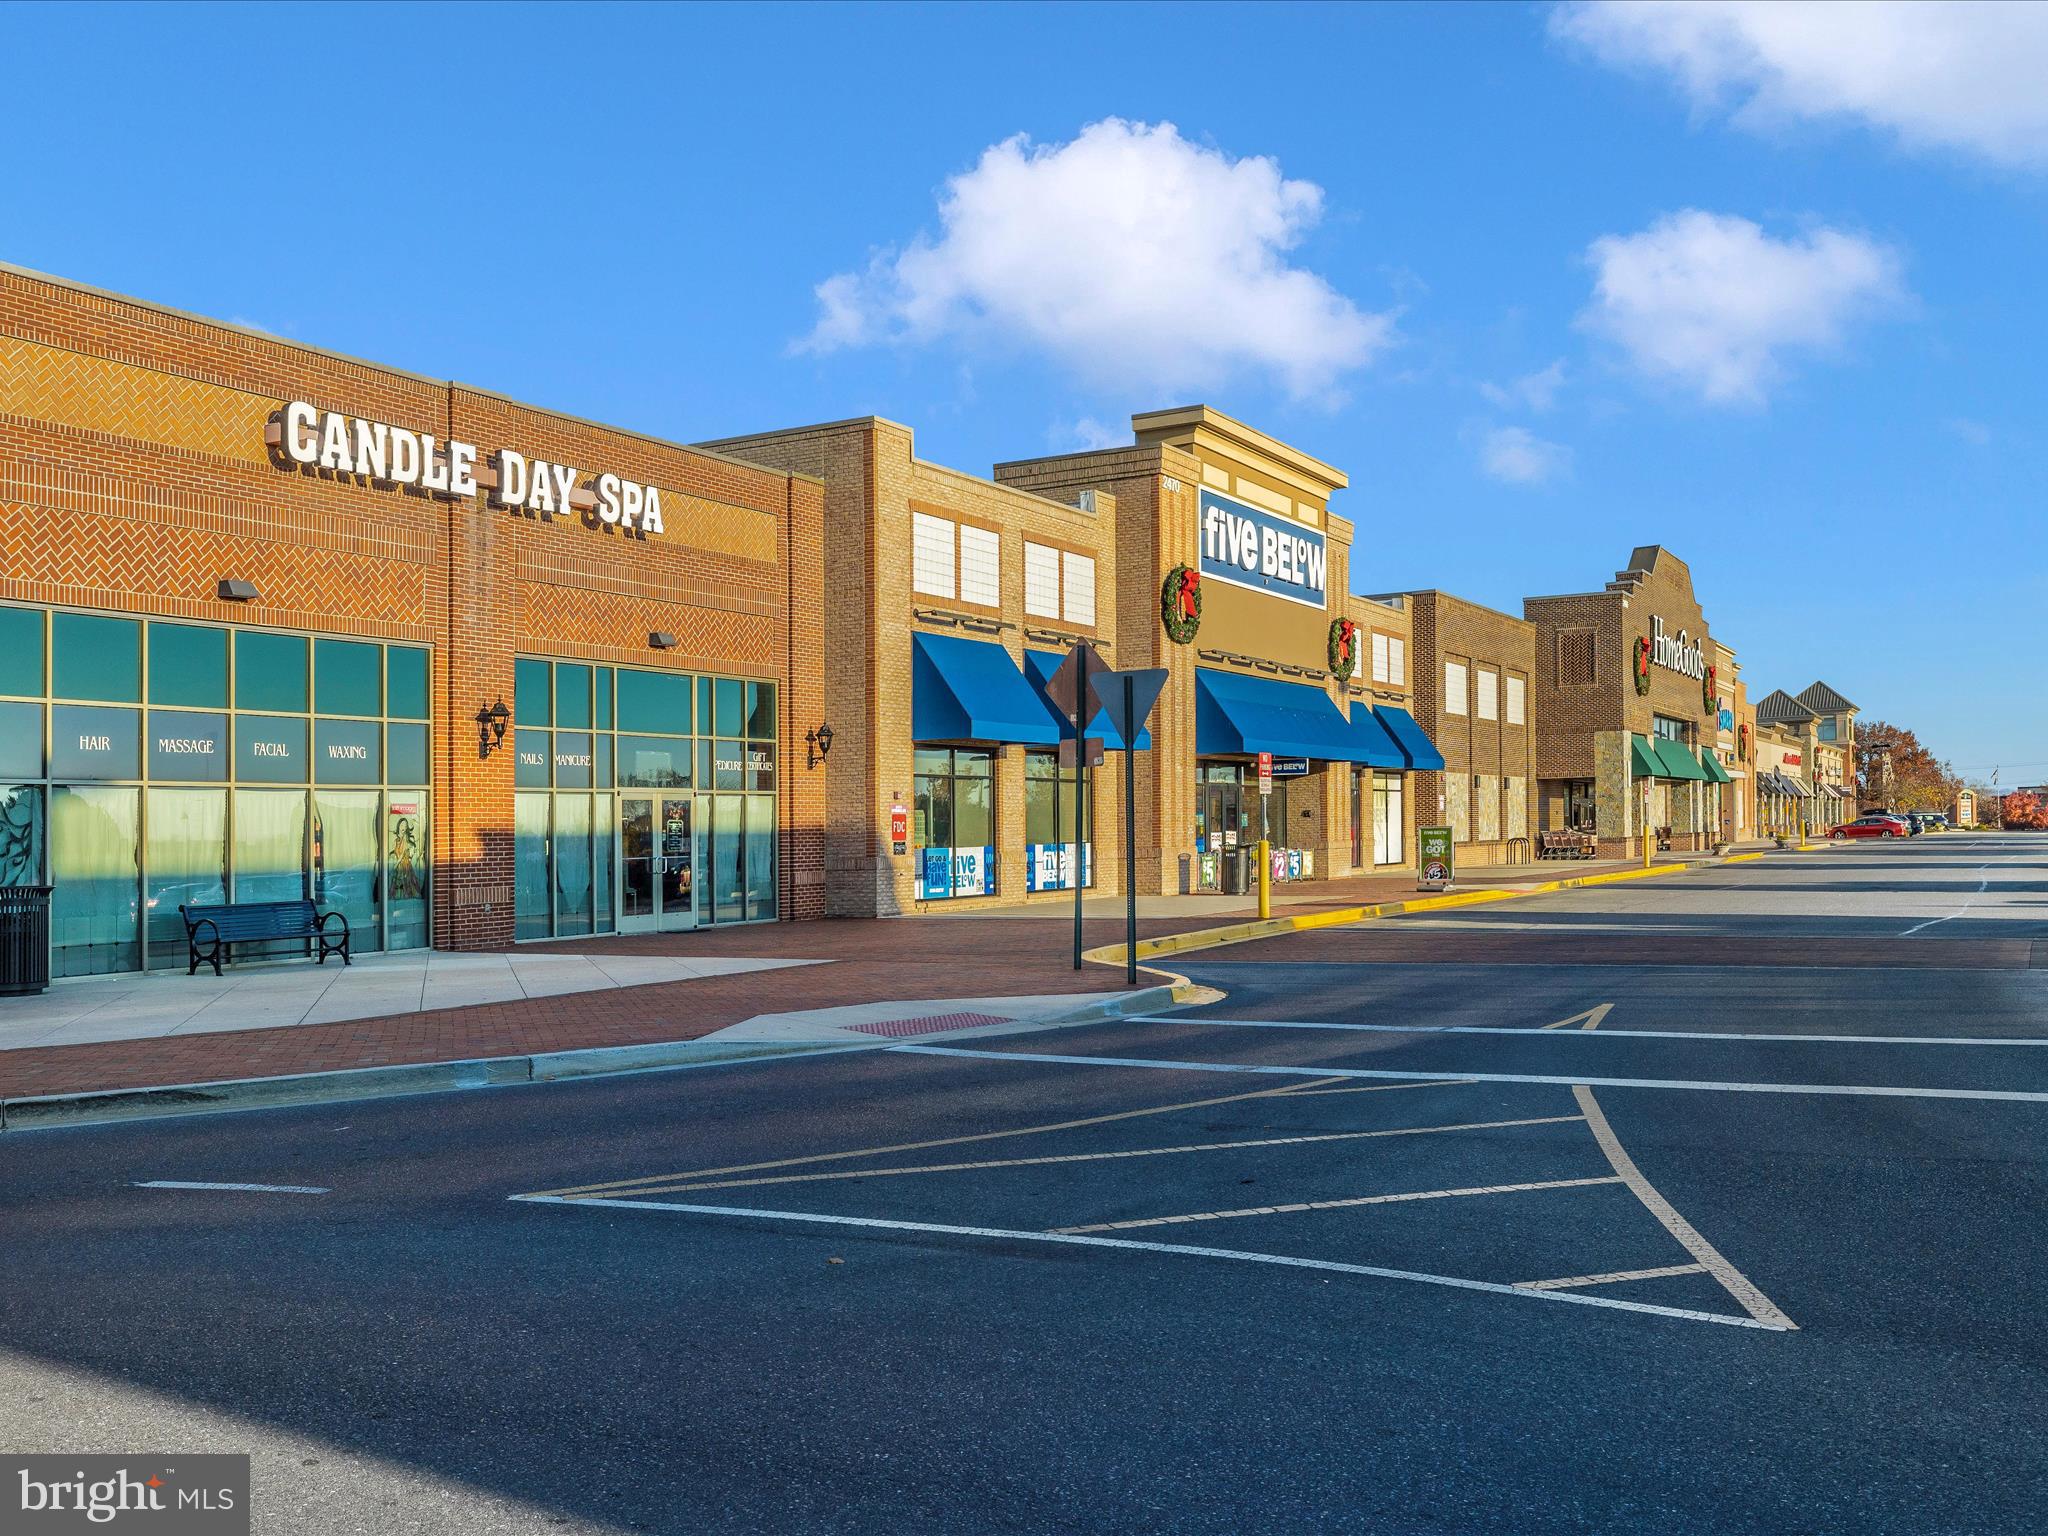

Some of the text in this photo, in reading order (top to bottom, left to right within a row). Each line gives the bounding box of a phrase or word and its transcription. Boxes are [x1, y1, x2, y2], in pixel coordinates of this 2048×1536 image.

[286, 401, 665, 534] CANDLE DAY SPA
[1162, 475, 1180, 493] 2470
[1206, 505, 1326, 591] five BELOW
[1653, 615, 1703, 681] HomeGoods
[79, 735, 111, 752] HAIR
[158, 738, 214, 755] MASSAGE
[252, 741, 290, 758] FACIAL
[328, 744, 367, 760] WAXING
[519, 752, 544, 766] NAILS
[555, 754, 592, 767] MANICURE
[715, 760, 743, 771] PEDICURE
[753, 752, 767, 762] GIFT
[893, 821, 906, 833] FDC
[1425, 845, 1446, 854] GOT
[1202, 860, 1214, 883] $5
[1275, 857, 1285, 877] $2
[1289, 856, 1300, 876] $5
